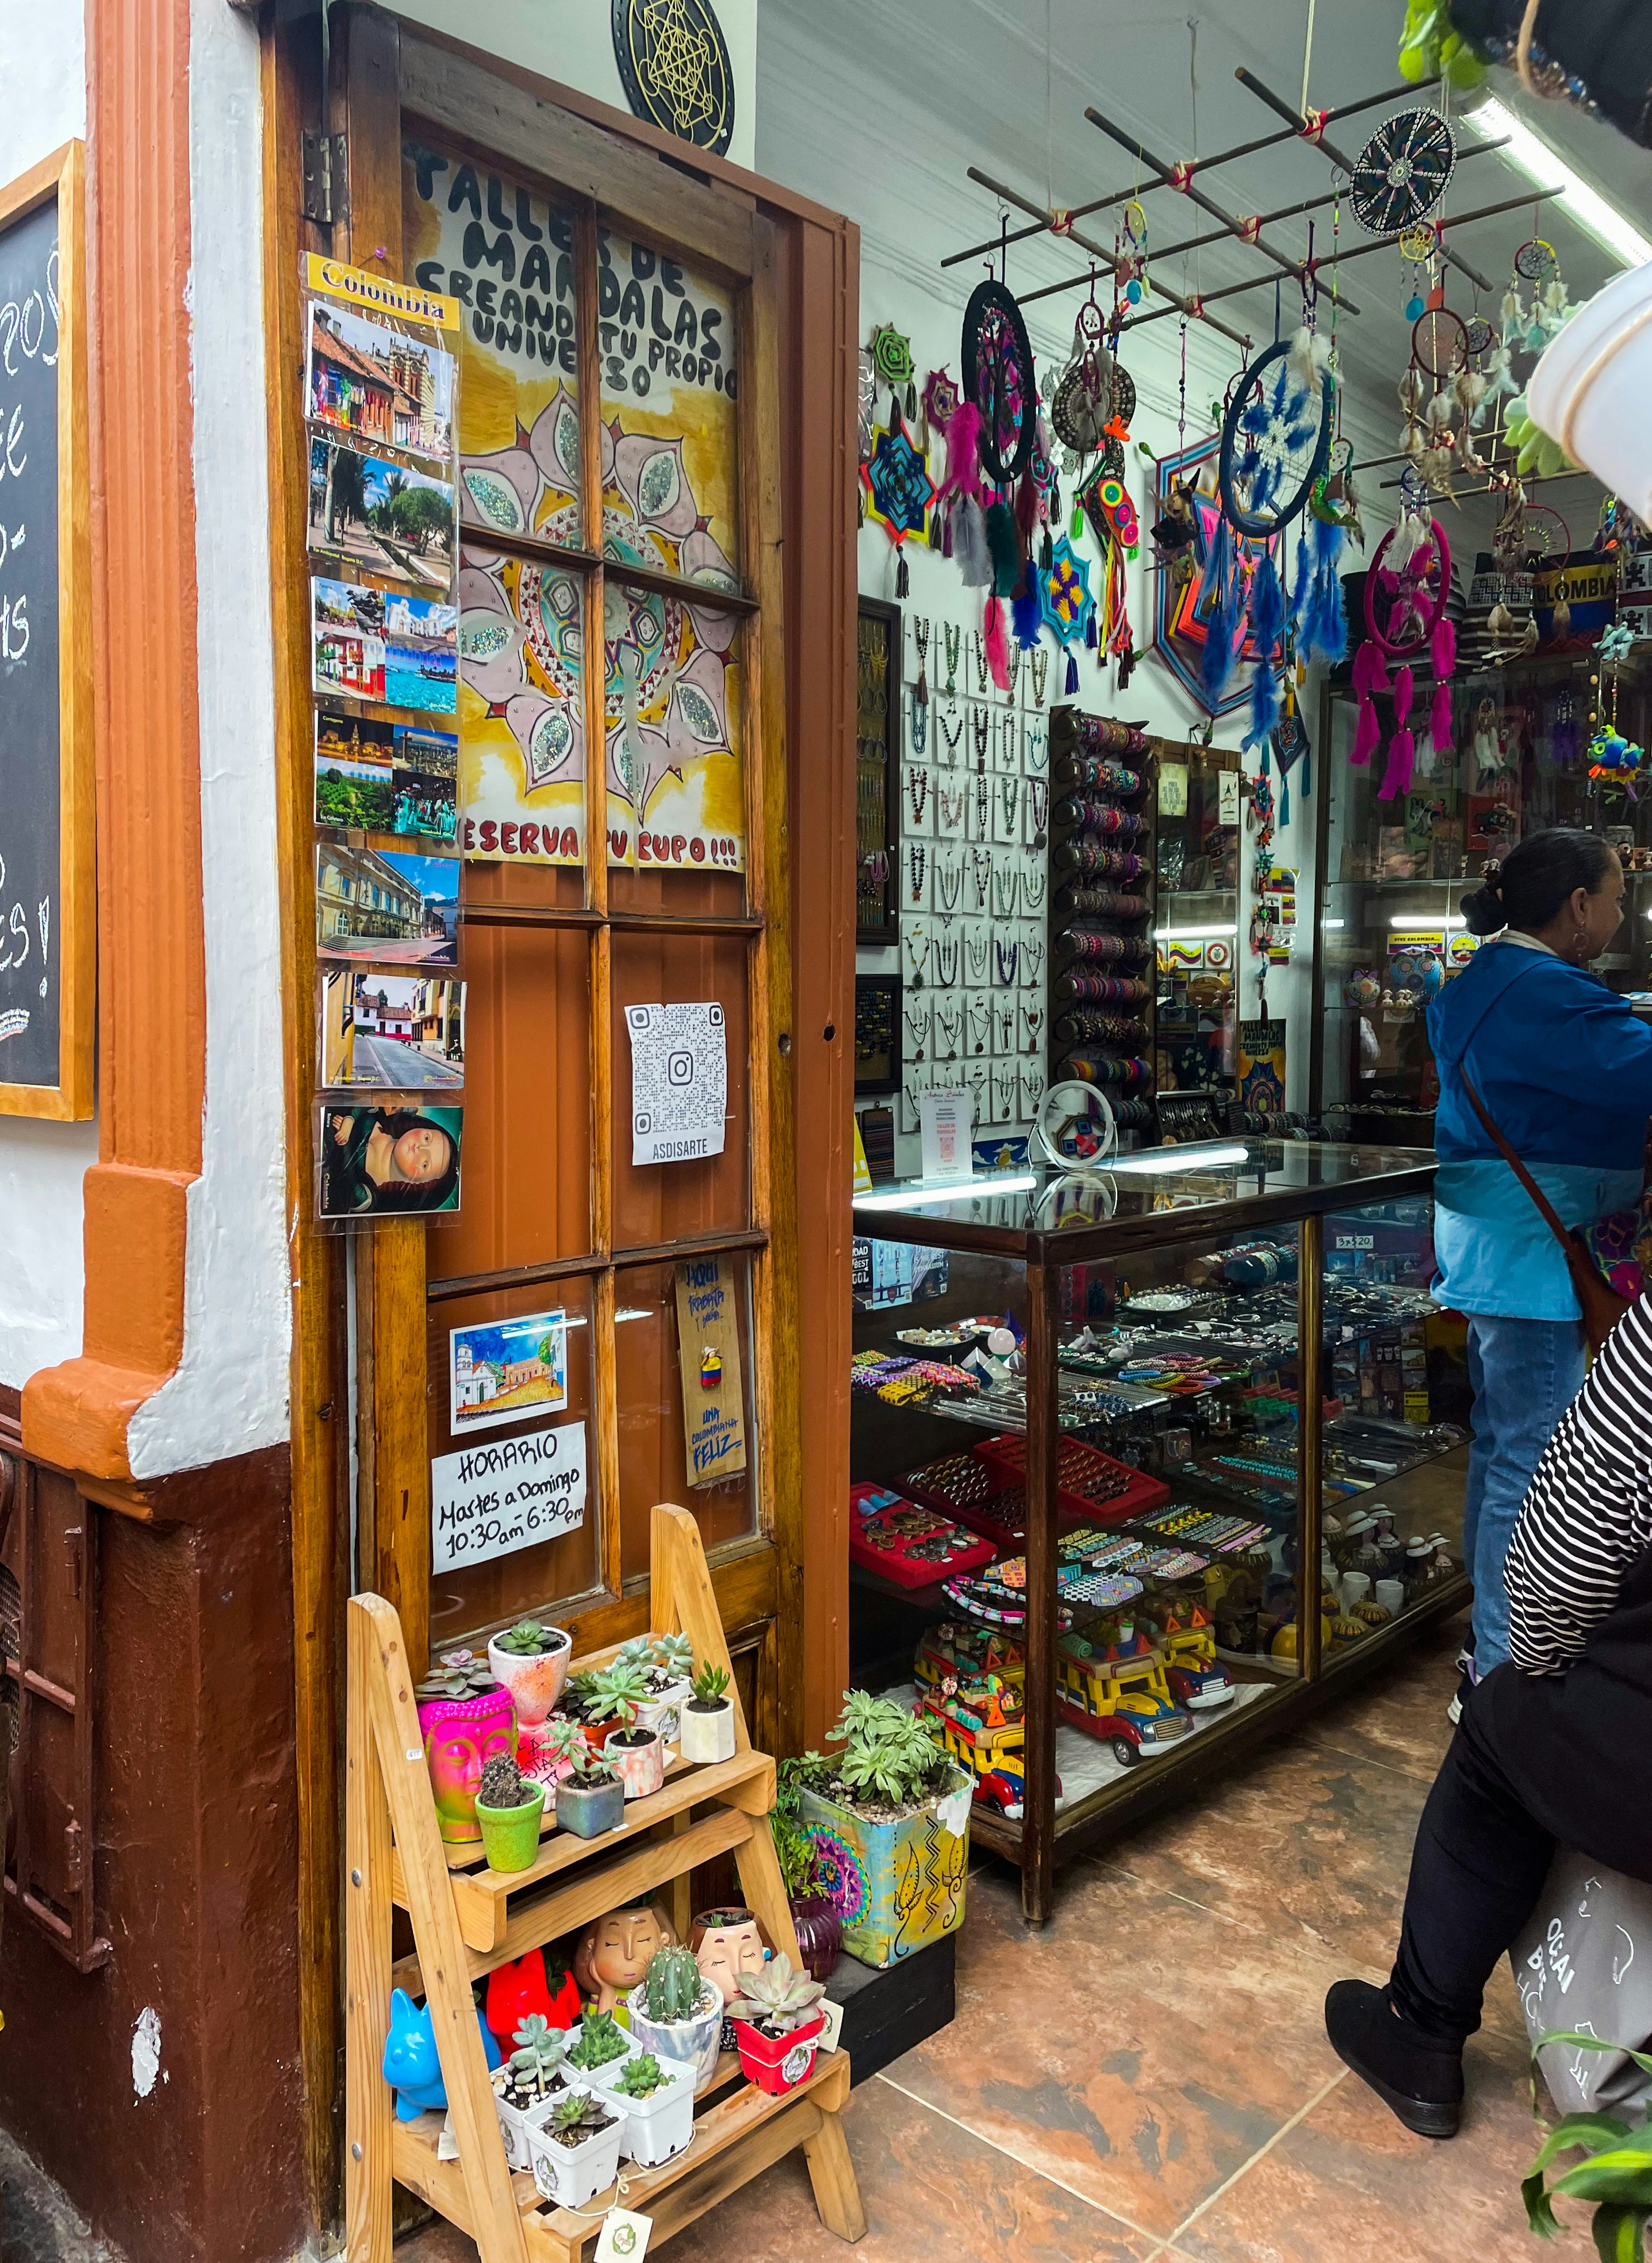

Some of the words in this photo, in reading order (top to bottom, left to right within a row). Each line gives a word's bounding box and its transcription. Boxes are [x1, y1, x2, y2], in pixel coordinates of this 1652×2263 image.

[322, 262, 444, 319] Colombia
[631, 240, 685, 297] DE
[416, 261, 573, 337] CREAND
[599, 323, 637, 360] TU
[649, 338, 737, 399] PROPIO
[473, 311, 650, 397] UNIVESO
[1536, 575, 1616, 603] OLOMBIA
[454, 817, 578, 857] ESERVA
[607, 830, 627, 859] U
[639, 832, 737, 866] CUPO!!!
[653, 1139, 707, 1160] ASDISARTE
[854, 1258, 869, 1269] BEST
[688, 1286, 725, 1317] TRABAJA
[703, 1407, 720, 1426] UNA
[458, 1434, 557, 1484] HORARIO
[439, 1491, 500, 1530] Martes
[505, 1491, 517, 1505] a
[517, 1468, 580, 1502] Domingo
